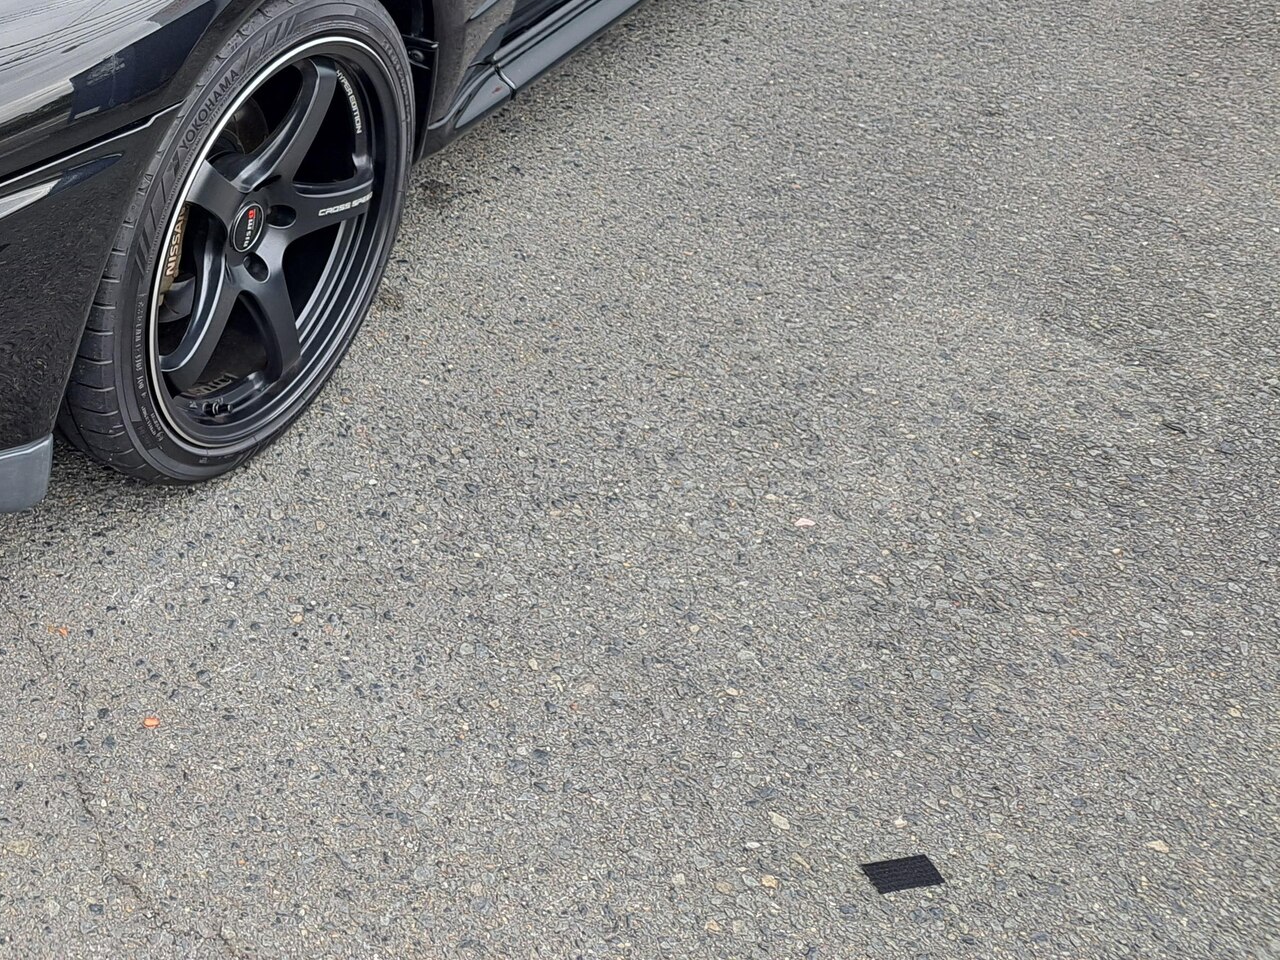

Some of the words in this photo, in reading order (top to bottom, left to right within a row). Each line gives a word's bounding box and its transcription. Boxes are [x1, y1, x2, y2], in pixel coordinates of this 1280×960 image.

[179, 68, 240, 150] YOKOHAMA
[336, 69, 354, 96] HYPER
[348, 94, 363, 135] EDITION
[318, 201, 352, 217] CROSS
